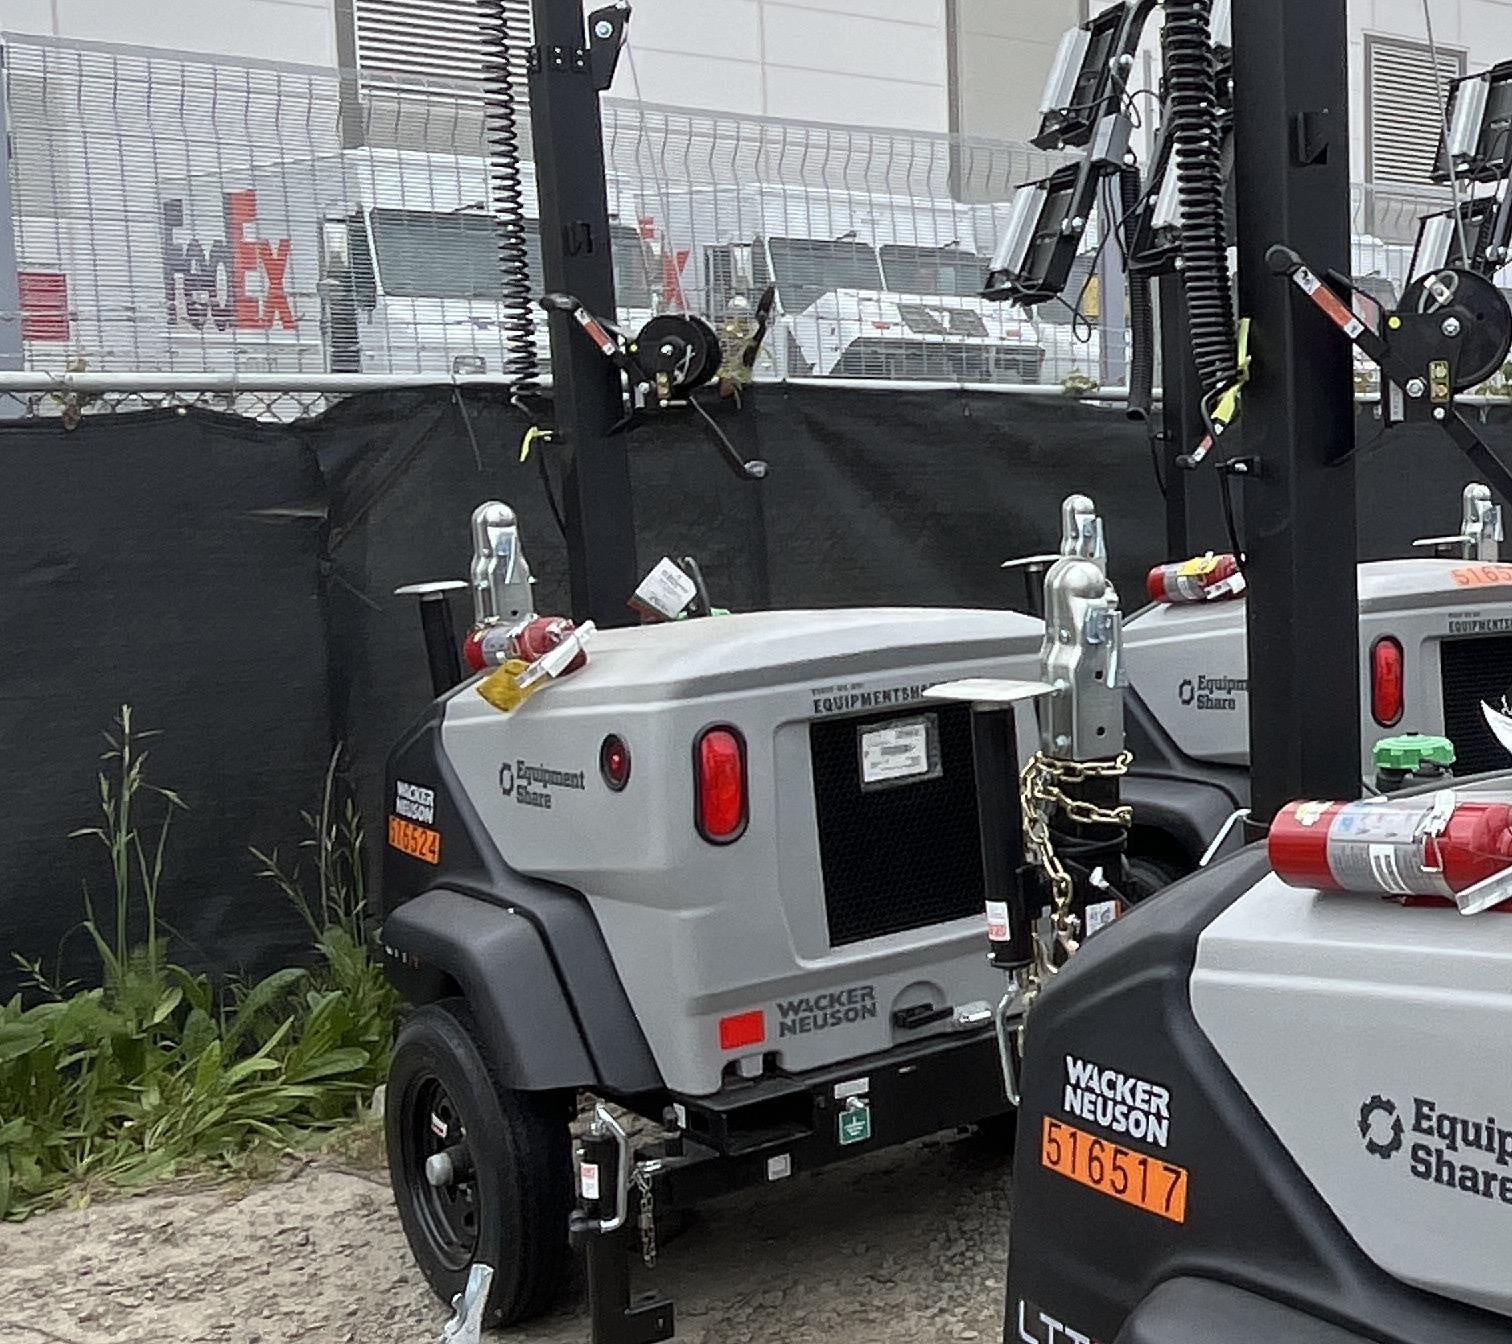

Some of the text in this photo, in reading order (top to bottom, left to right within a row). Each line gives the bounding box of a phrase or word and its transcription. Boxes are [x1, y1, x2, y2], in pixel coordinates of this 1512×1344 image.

[163, 189, 298, 332] FedEx
[1198, 674, 1248, 696] Equipm
[516, 760, 585, 790] Equipment
[516, 784, 551, 810] Share
[776, 985, 876, 1019] WACKER
[779, 1002, 877, 1037] NEUSON
[1065, 1054, 1171, 1118] WACKER
[1063, 1084, 1170, 1149] NEUSON
[1046, 1122, 1182, 1213] 516517
